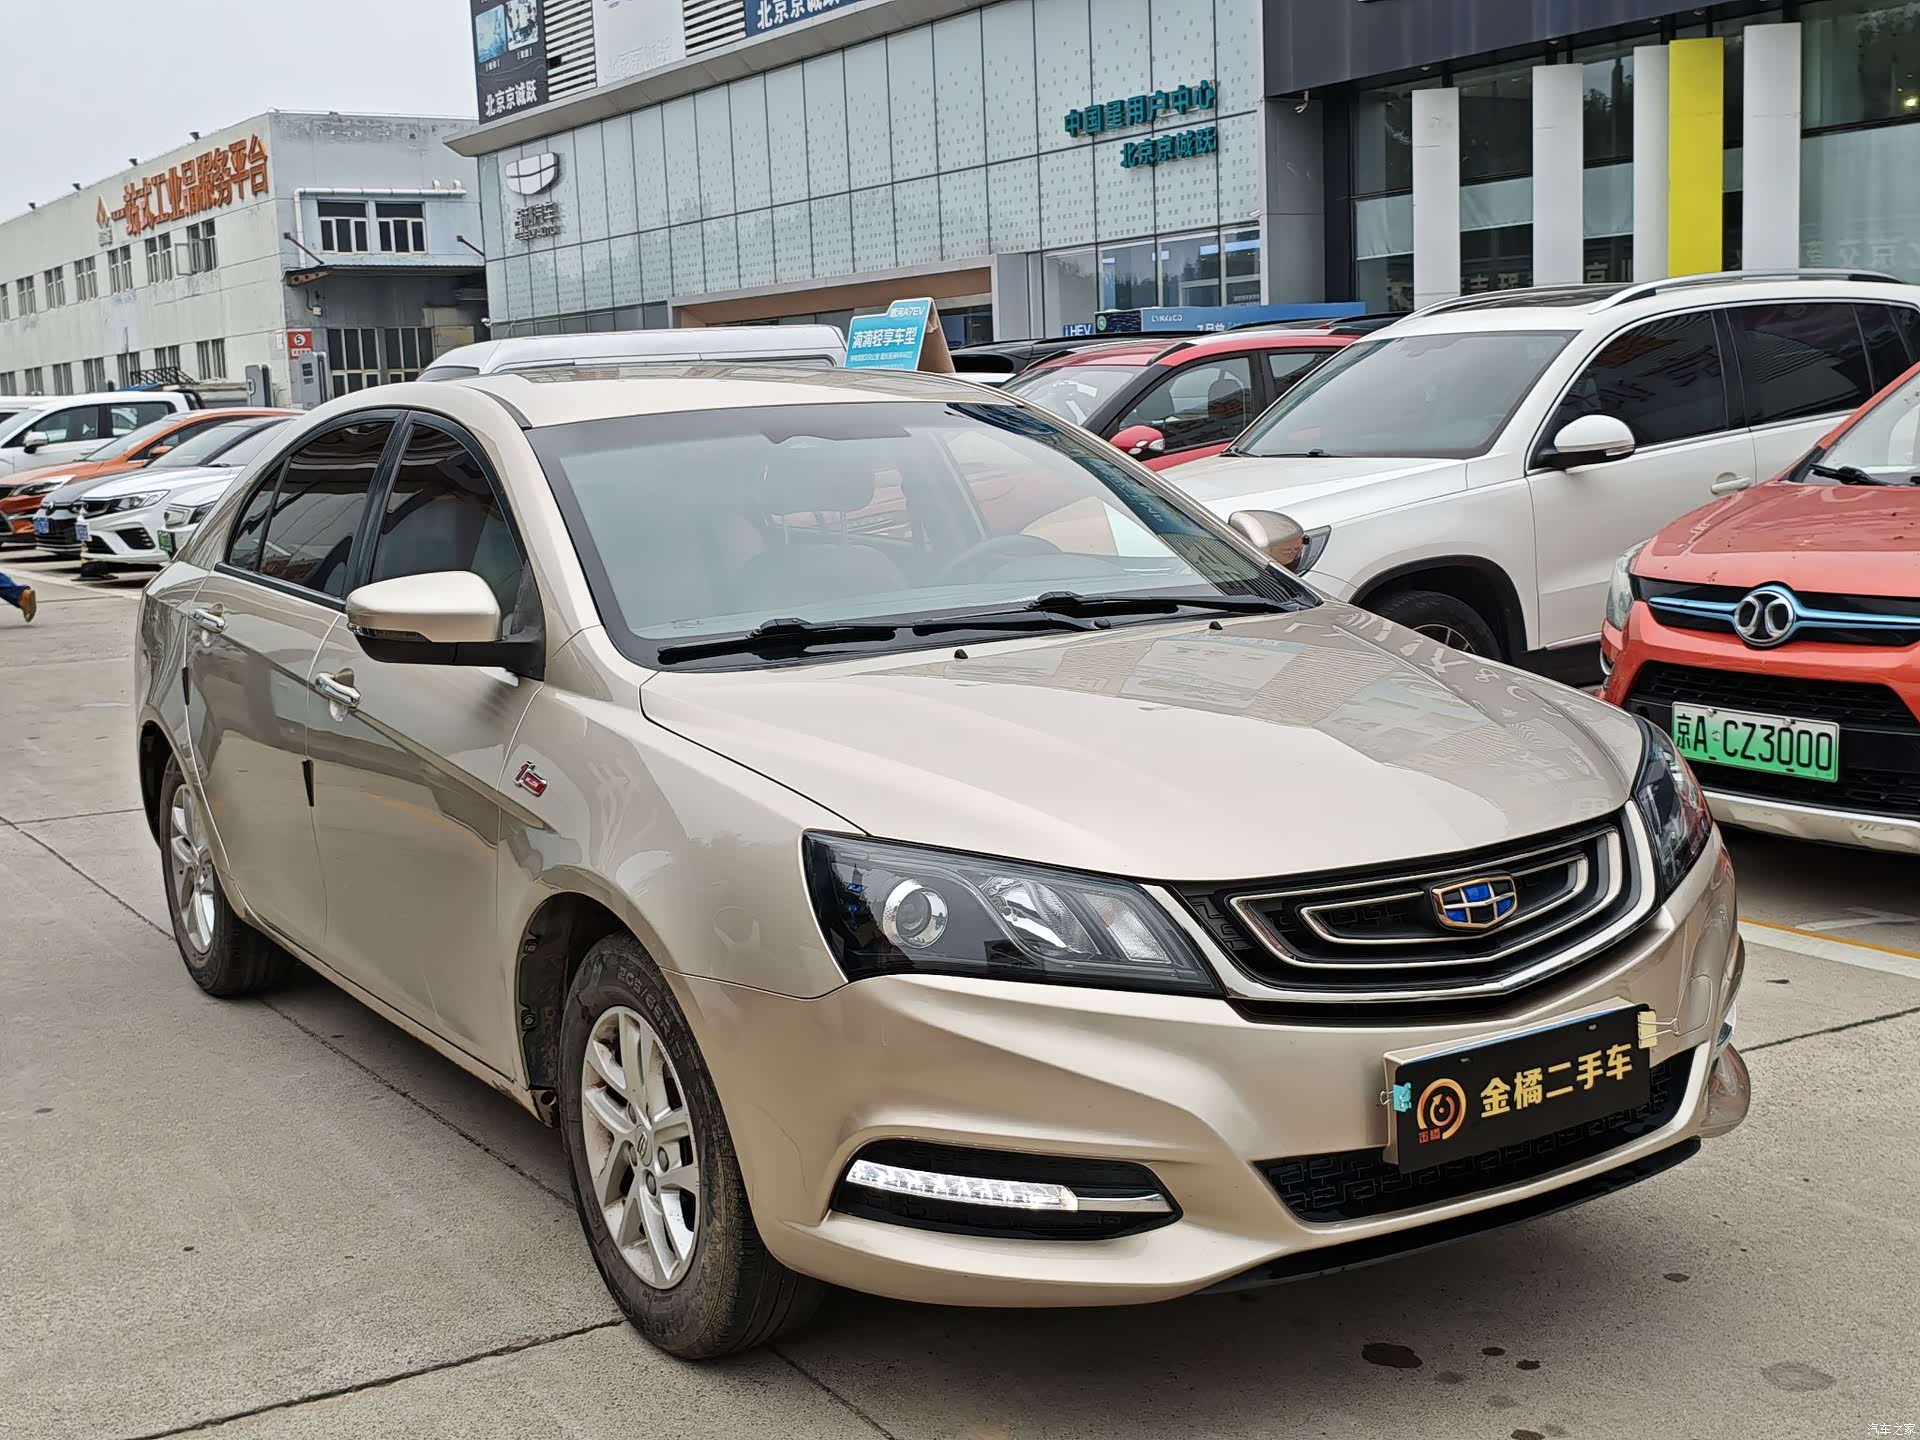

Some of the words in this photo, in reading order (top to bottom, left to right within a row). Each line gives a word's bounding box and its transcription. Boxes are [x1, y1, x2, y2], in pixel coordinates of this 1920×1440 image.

[485, 79, 538, 117] 北京京诚跃
[1064, 80, 1215, 138] 中国星用户中心
[1120, 126, 1216, 168] 北京京诚跃
[110, 133, 268, 237] 一站式工业品服务平台
[852, 326, 918, 349] 滴滴轻享车型
[1480, 1043, 1633, 1118] 金橘二手车
